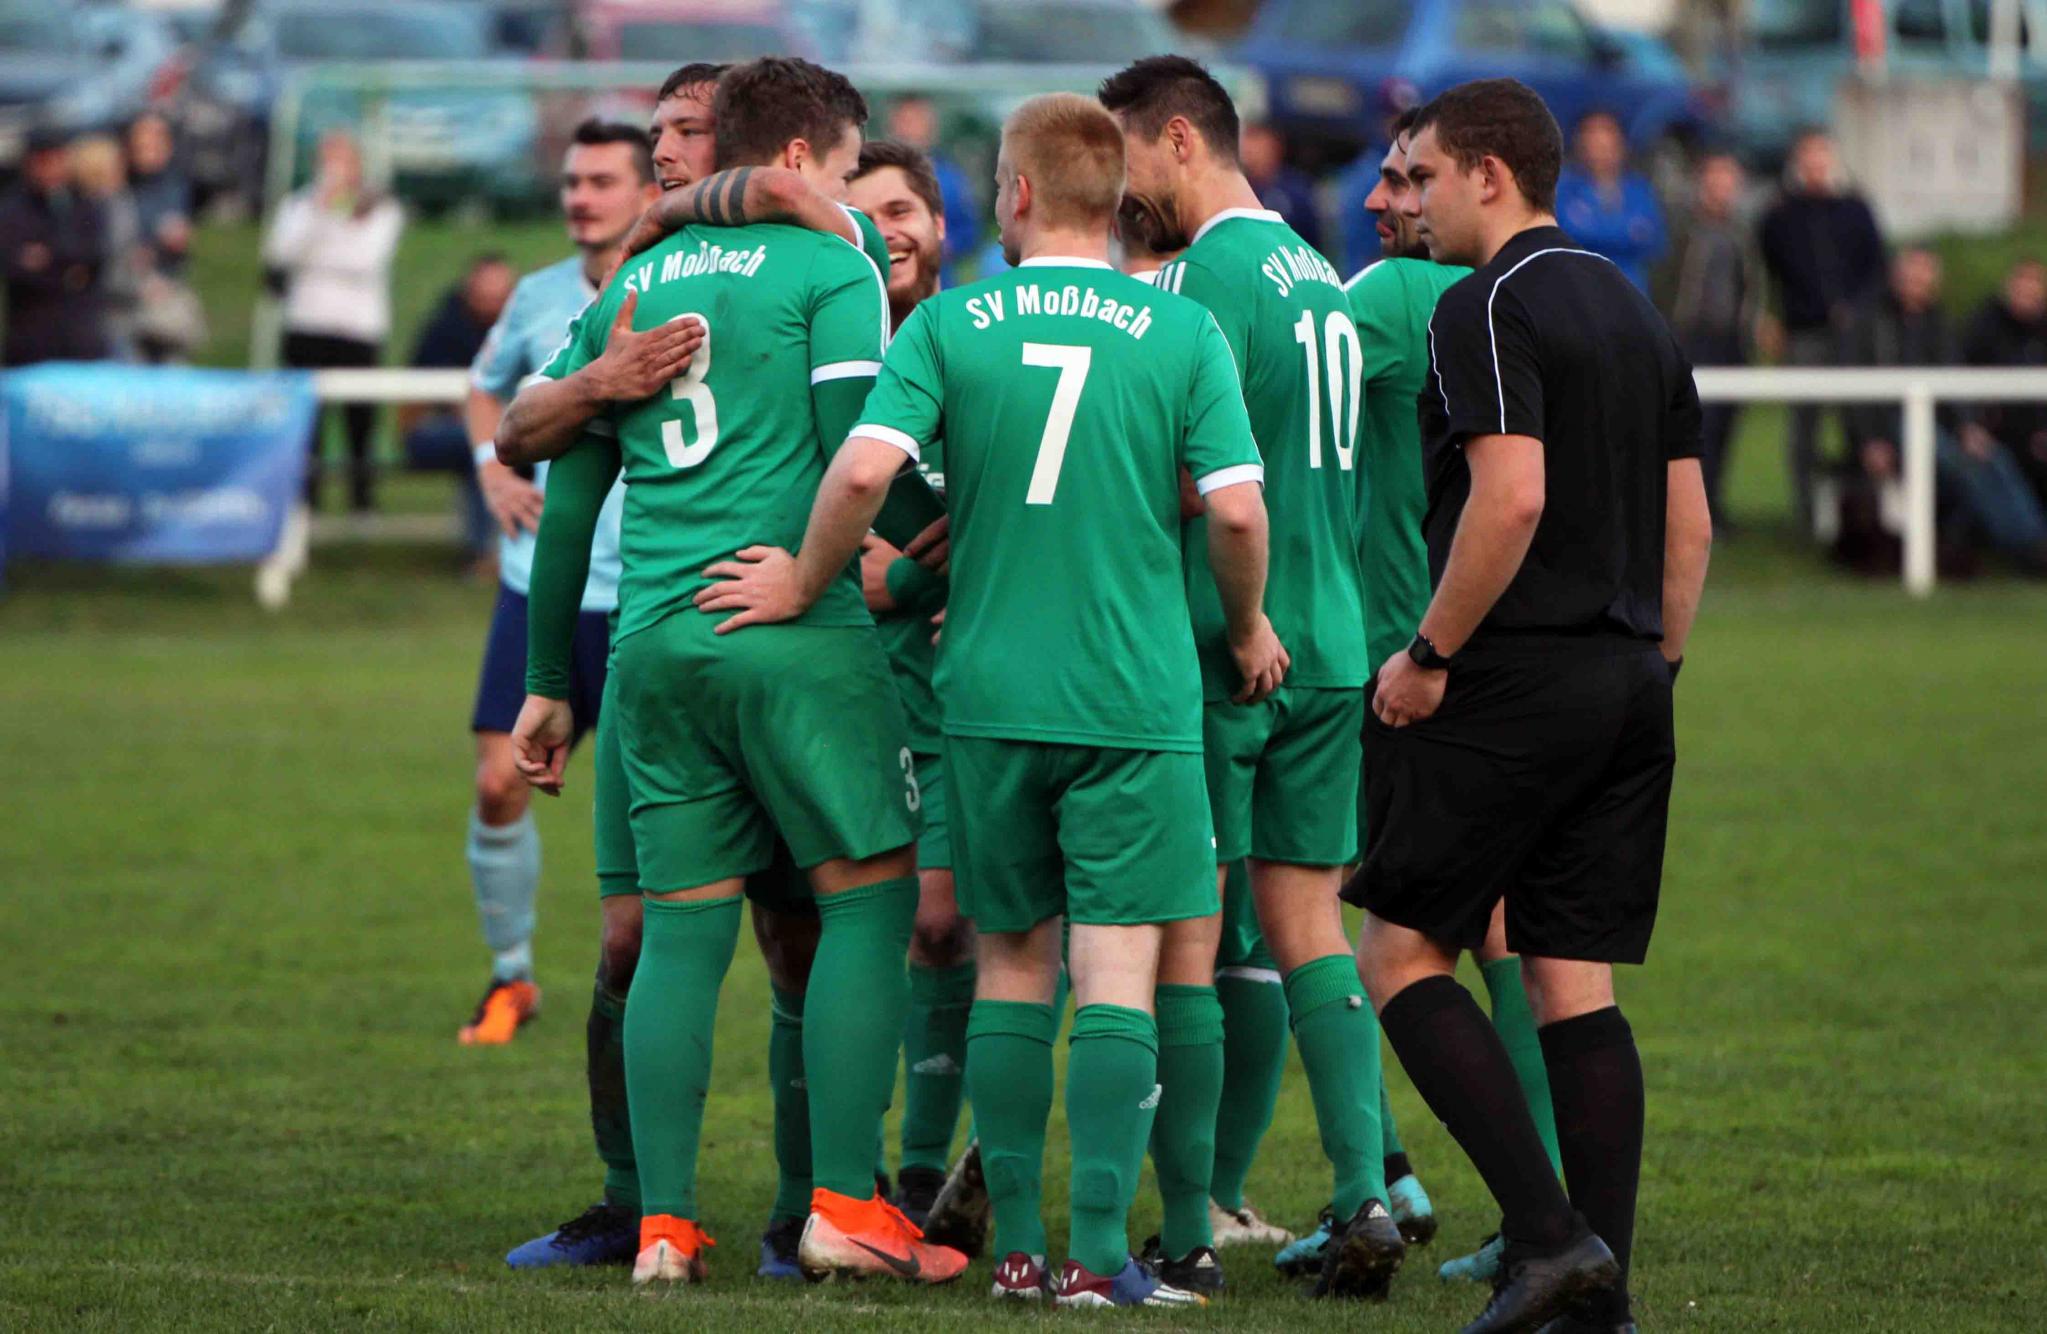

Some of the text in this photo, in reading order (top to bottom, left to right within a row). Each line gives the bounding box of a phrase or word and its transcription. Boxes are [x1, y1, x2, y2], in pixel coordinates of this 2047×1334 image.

[624, 261, 654, 298] SV
[1262, 252, 1294, 298] SV
[965, 284, 1153, 340] SV Moßbach
[661, 312, 719, 469] 3
[1294, 309, 1364, 470] 10
[1022, 342, 1092, 504] 7
[900, 746, 921, 812] 3
